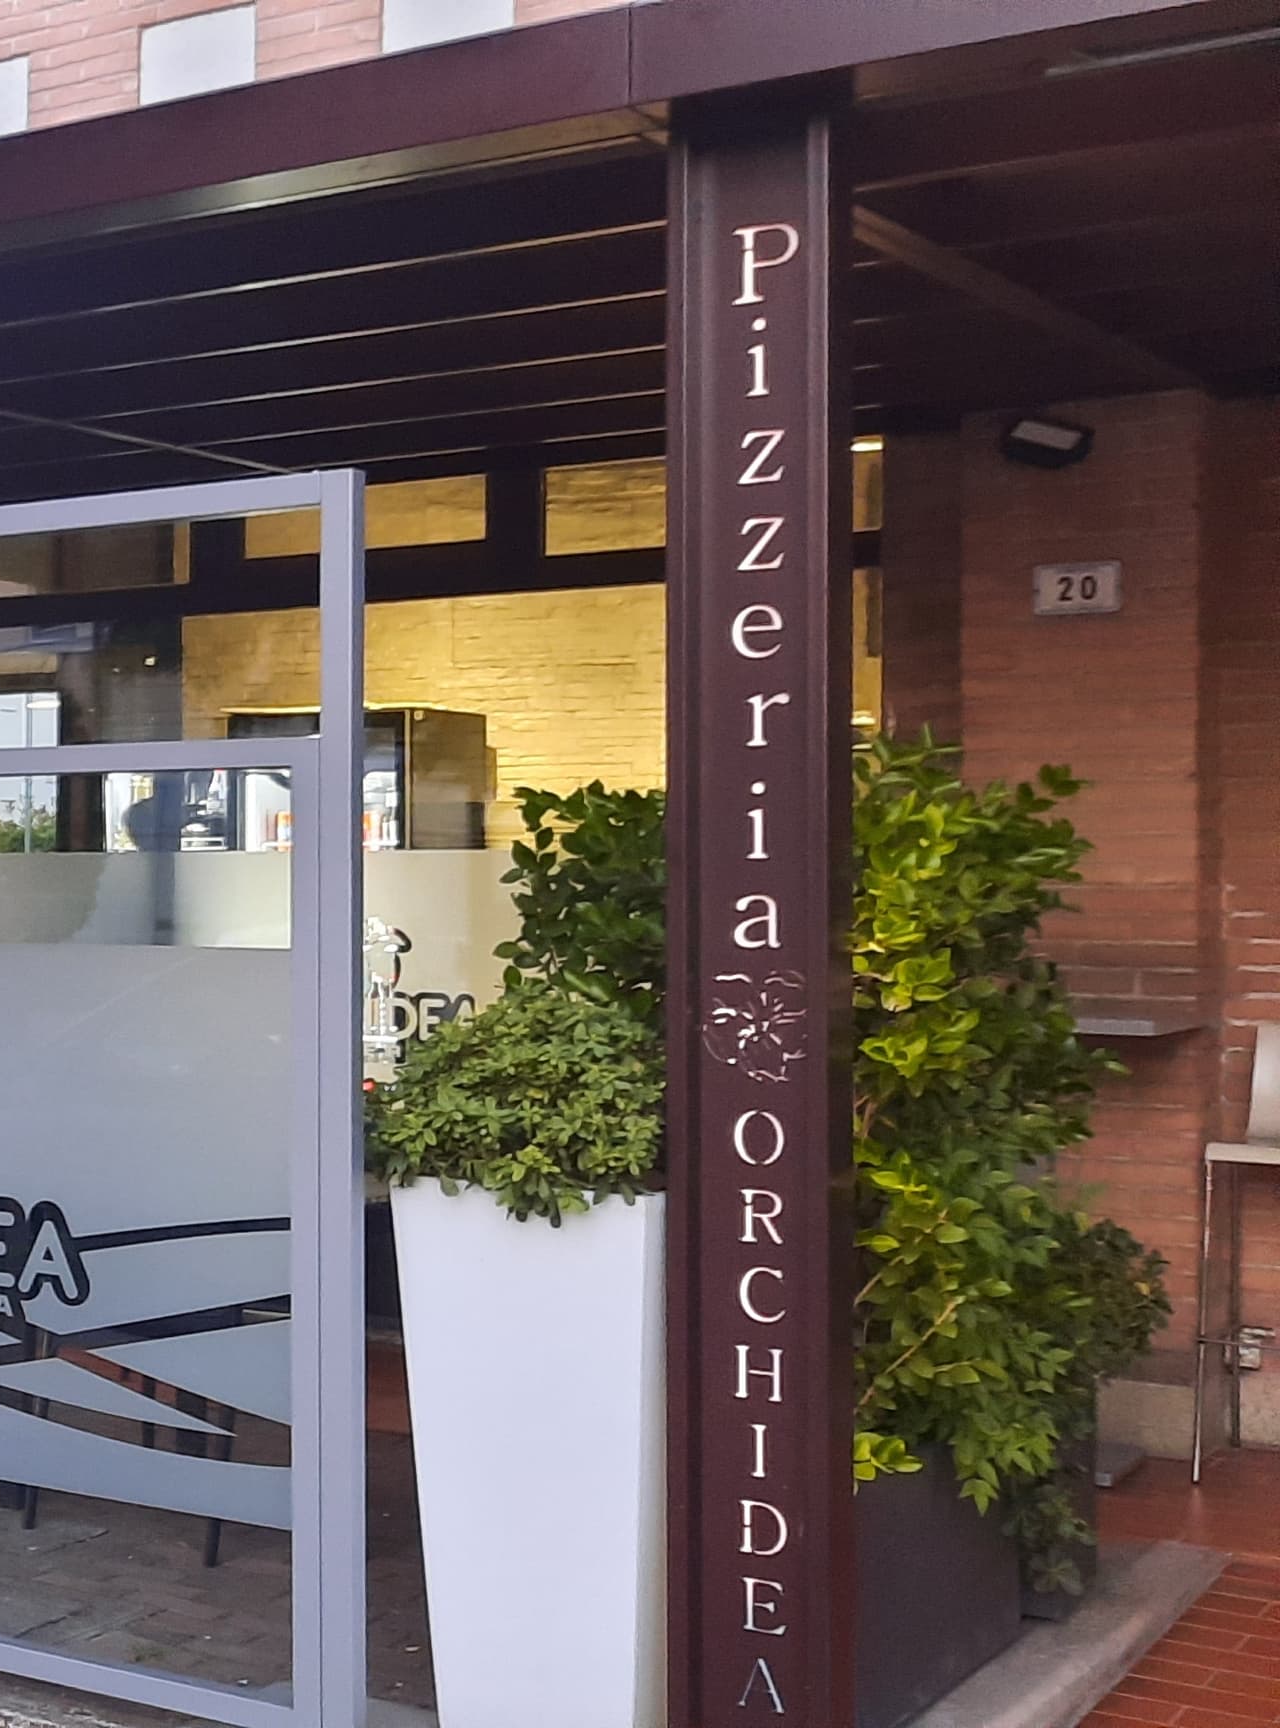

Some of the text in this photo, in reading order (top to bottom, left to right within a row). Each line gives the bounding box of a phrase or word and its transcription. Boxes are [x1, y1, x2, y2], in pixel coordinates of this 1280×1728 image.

[730, 222, 800, 950] Pizzeria
[1057, 575, 1098, 602] 20
[731, 1108, 788, 1715] ORCHIDEA
